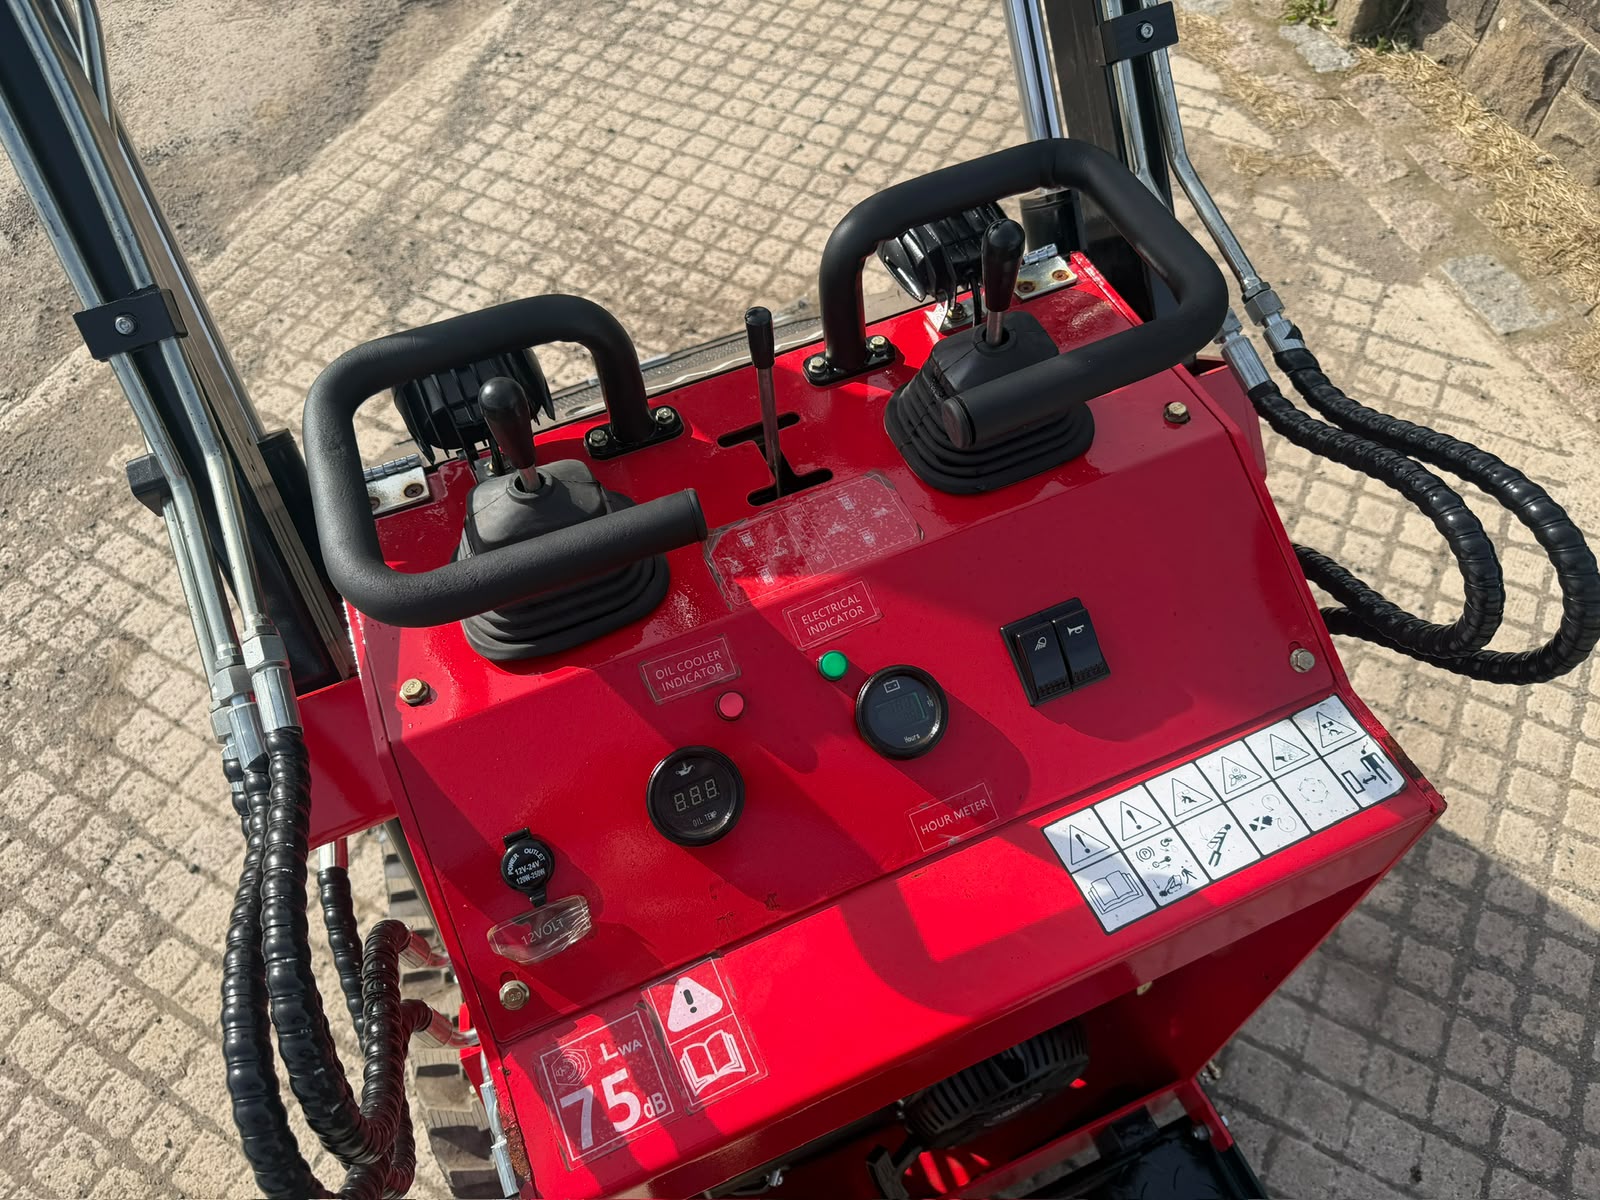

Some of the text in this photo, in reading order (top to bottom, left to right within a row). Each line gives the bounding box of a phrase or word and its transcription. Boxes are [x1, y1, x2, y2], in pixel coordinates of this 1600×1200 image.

[801, 594, 862, 625] ELECTRICAL
[806, 605, 865, 637] INDICATOR
[655, 650, 722, 681] OIL COOLER
[661, 662, 724, 692] INDICATOR
[693, 810, 717, 827] OIL TEMP
[920, 799, 989, 835] HOUR METER
[507, 847, 546, 876] POWER OUTLET
[514, 860, 540, 876] 12V-24V
